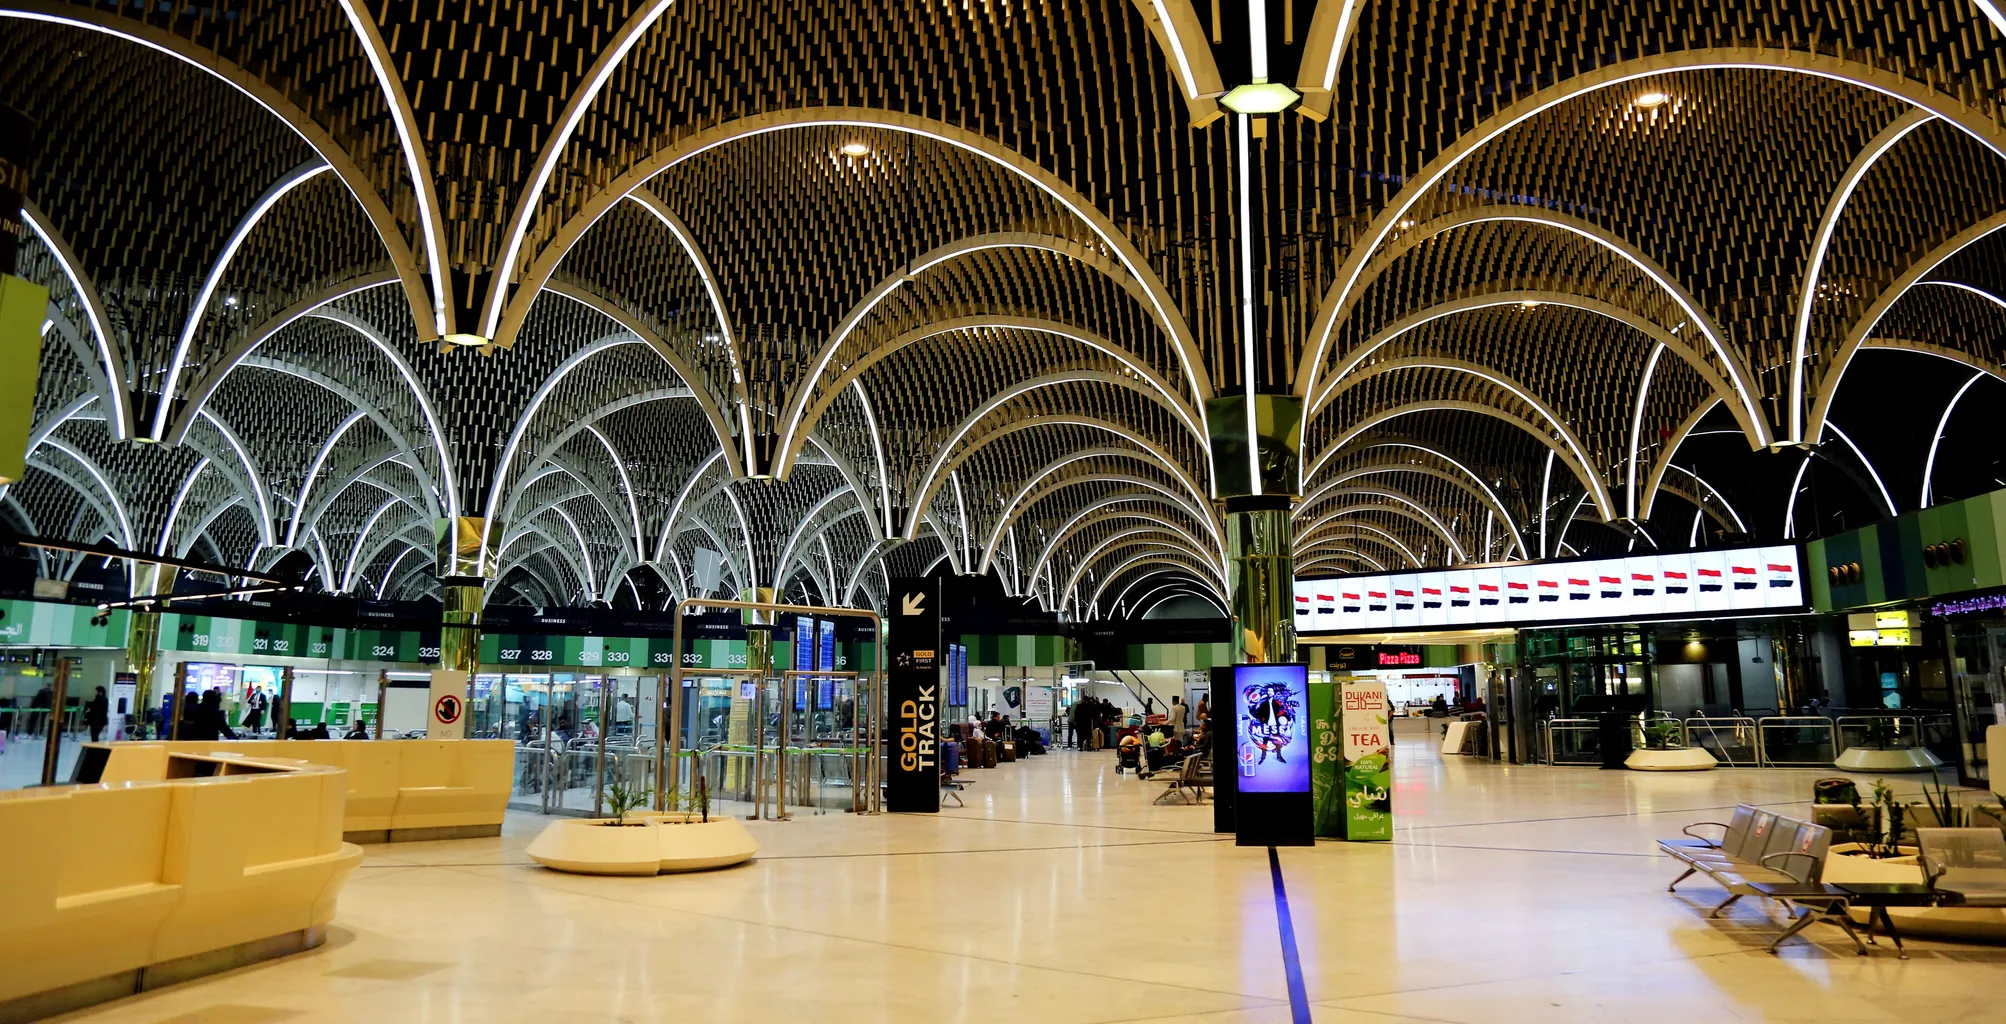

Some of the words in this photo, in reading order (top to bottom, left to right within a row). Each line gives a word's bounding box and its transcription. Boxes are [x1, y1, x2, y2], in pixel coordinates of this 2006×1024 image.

[78, 582, 104, 590] BUSINESS
[192, 634, 209, 646] 319
[216, 636, 233, 647] 320
[253, 638, 269, 650] 321
[273, 640, 289, 651] 322
[312, 643, 327, 653] 323
[372, 646, 395, 656] 324
[418, 647, 440, 657] 325
[500, 649, 522, 660] 327
[531, 650, 553, 660] 328
[578, 651, 600, 661] 329
[607, 652, 630, 662] 330
[654, 652, 673, 663] 331
[682, 654, 703, 664] 332
[1379, 652, 1399, 665] Pizza
[1400, 652, 1420, 664] Pizza
[918, 684, 935, 772] TRACK
[440, 730, 452, 738] NO
[901, 700, 917, 772] GOLD
[1351, 733, 1381, 747] TEA
